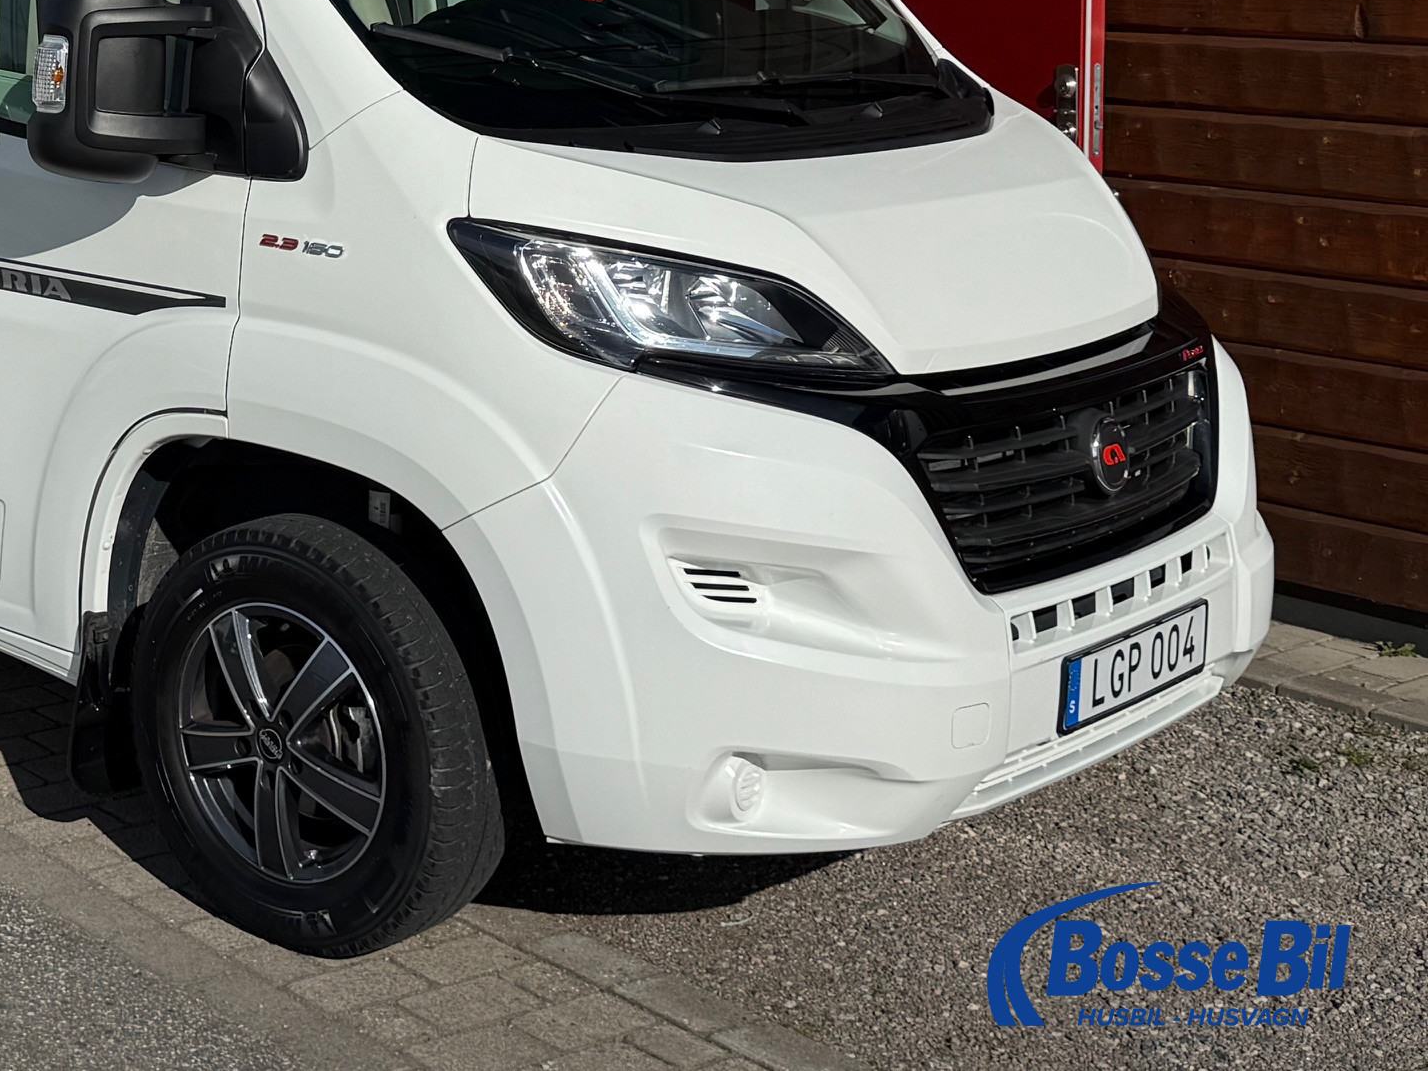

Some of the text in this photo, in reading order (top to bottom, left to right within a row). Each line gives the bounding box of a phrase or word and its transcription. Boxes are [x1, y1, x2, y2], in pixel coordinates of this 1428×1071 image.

[259, 233, 299, 251] 2.3
[1092, 616, 1195, 707] LGP 004
[1069, 699, 1076, 714] S
